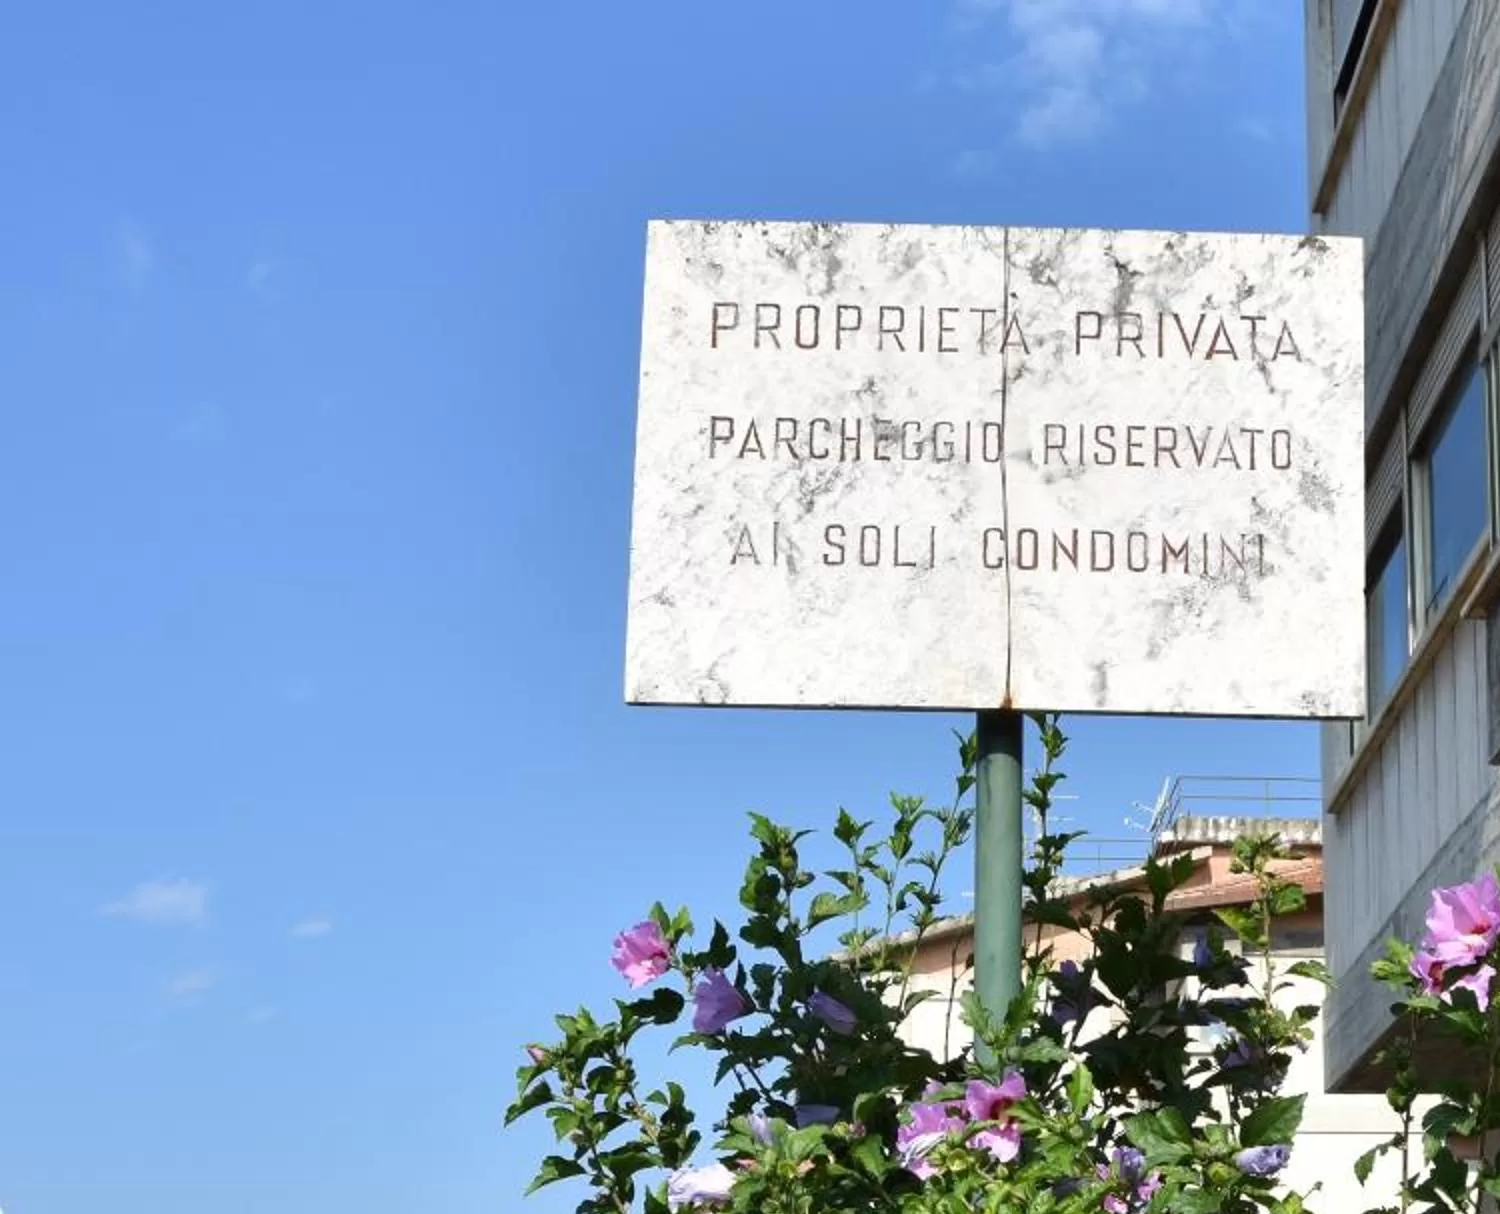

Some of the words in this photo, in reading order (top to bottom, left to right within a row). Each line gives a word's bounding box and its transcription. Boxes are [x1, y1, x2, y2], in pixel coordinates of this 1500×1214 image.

[1075, 309, 1303, 362] PRIVATA
[708, 413, 1002, 464] PARCHEGGIO
[1043, 422, 1293, 471] RISERVATO
[729, 520, 780, 566] AI
[822, 523, 937, 569] SOLI
[982, 526, 1265, 577] CONDOMINI
